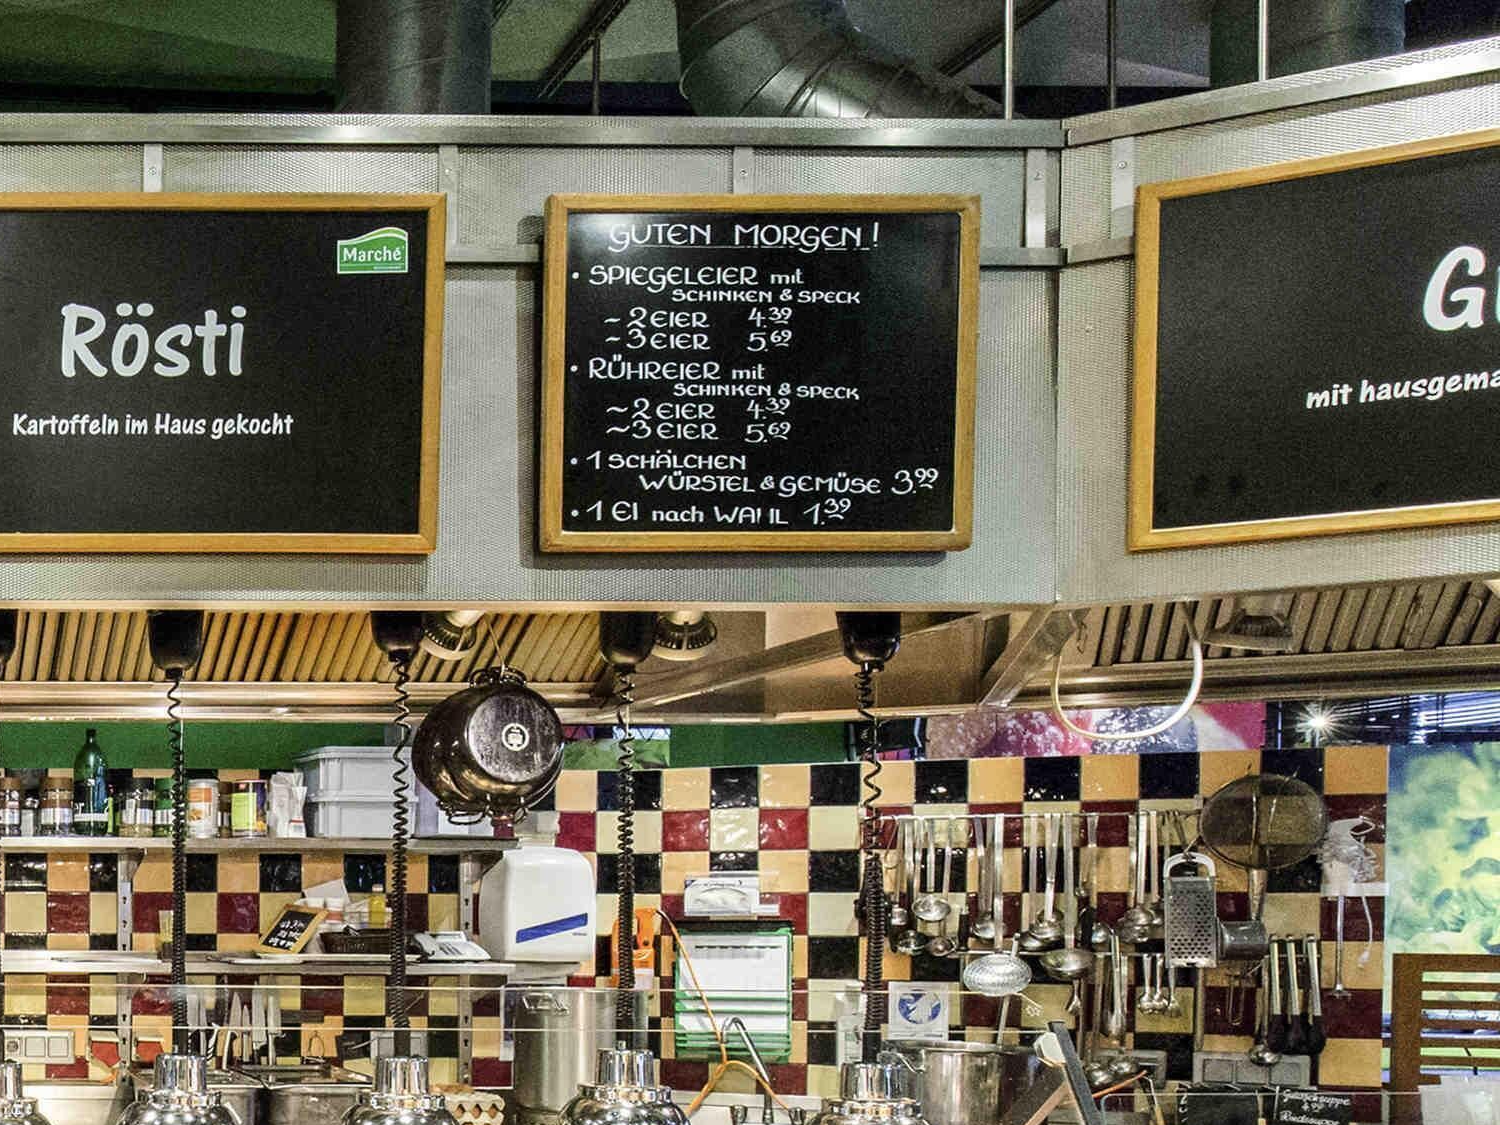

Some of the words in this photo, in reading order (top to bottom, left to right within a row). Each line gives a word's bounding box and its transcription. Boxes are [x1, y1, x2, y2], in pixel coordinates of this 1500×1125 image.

[608, 223, 711, 252] GUTEN
[343, 245, 402, 262] Marché
[589, 265, 759, 293] SPIEGELEIER
[770, 268, 804, 285] mit
[1422, 244, 1500, 332] G
[671, 288, 773, 303] SCHINKEN
[779, 288, 793, 301] &
[797, 289, 861, 305] SPECK
[60, 303, 247, 378] Rösti
[588, 353, 722, 380] RÜHREIER
[731, 363, 765, 380] mit
[673, 383, 772, 397] SCHINKEN
[777, 382, 792, 396] &
[796, 385, 860, 400] SPECK
[1305, 383, 1354, 409] mit
[12, 413, 120, 436] Kartoffeln
[125, 413, 148, 435] im
[154, 413, 206, 436] Haus
[211, 413, 294, 440] gekocht
[586, 450, 601, 470] 1
[608, 449, 747, 470] SCHÄLCHEN
[638, 470, 756, 493] WÜRSTEL
[760, 475, 775, 490] &
[778, 471, 882, 498] GEMÜSE
[586, 500, 603, 521] 1
[611, 500, 639, 522] EI
[652, 505, 704, 522] nach
